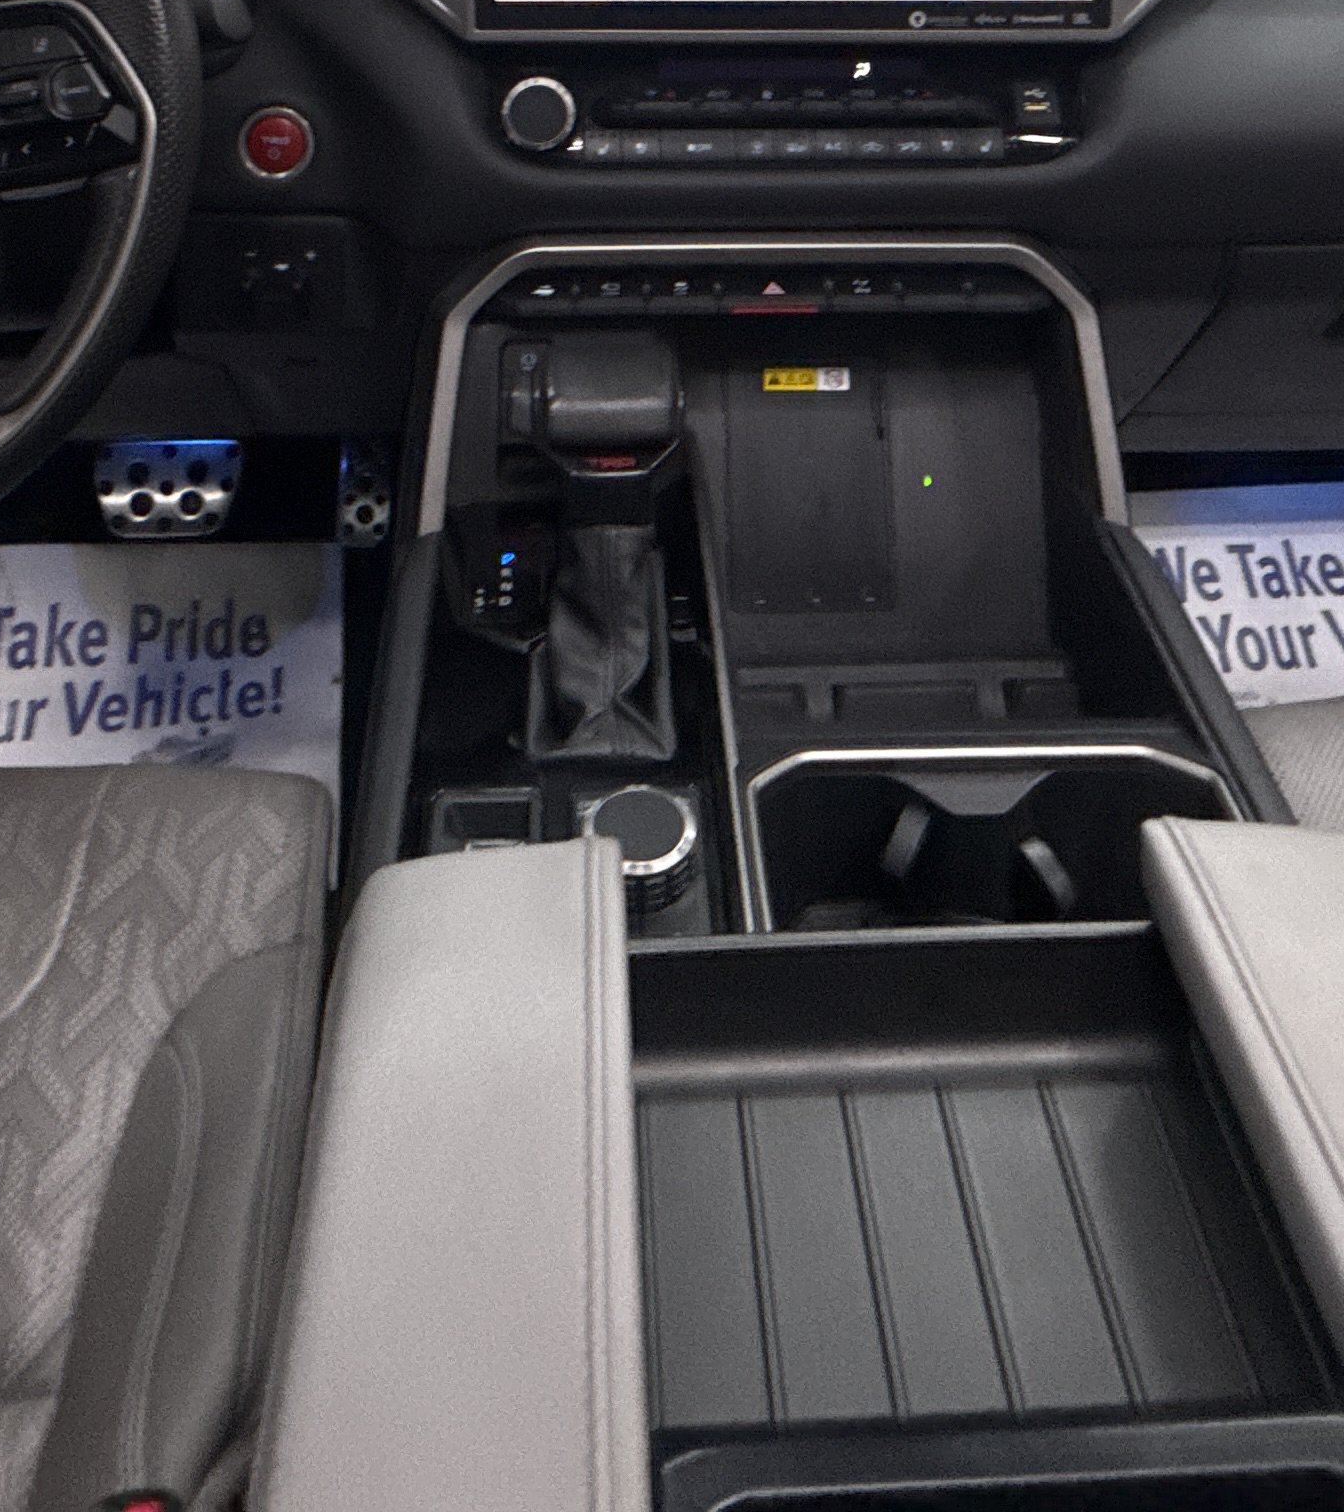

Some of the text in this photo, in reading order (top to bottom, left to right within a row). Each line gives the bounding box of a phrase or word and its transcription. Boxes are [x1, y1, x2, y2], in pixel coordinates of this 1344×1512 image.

[127, 597, 271, 666] Pride
[1196, 612, 1317, 674] Your
[62, 666, 284, 738] Vehicle!
